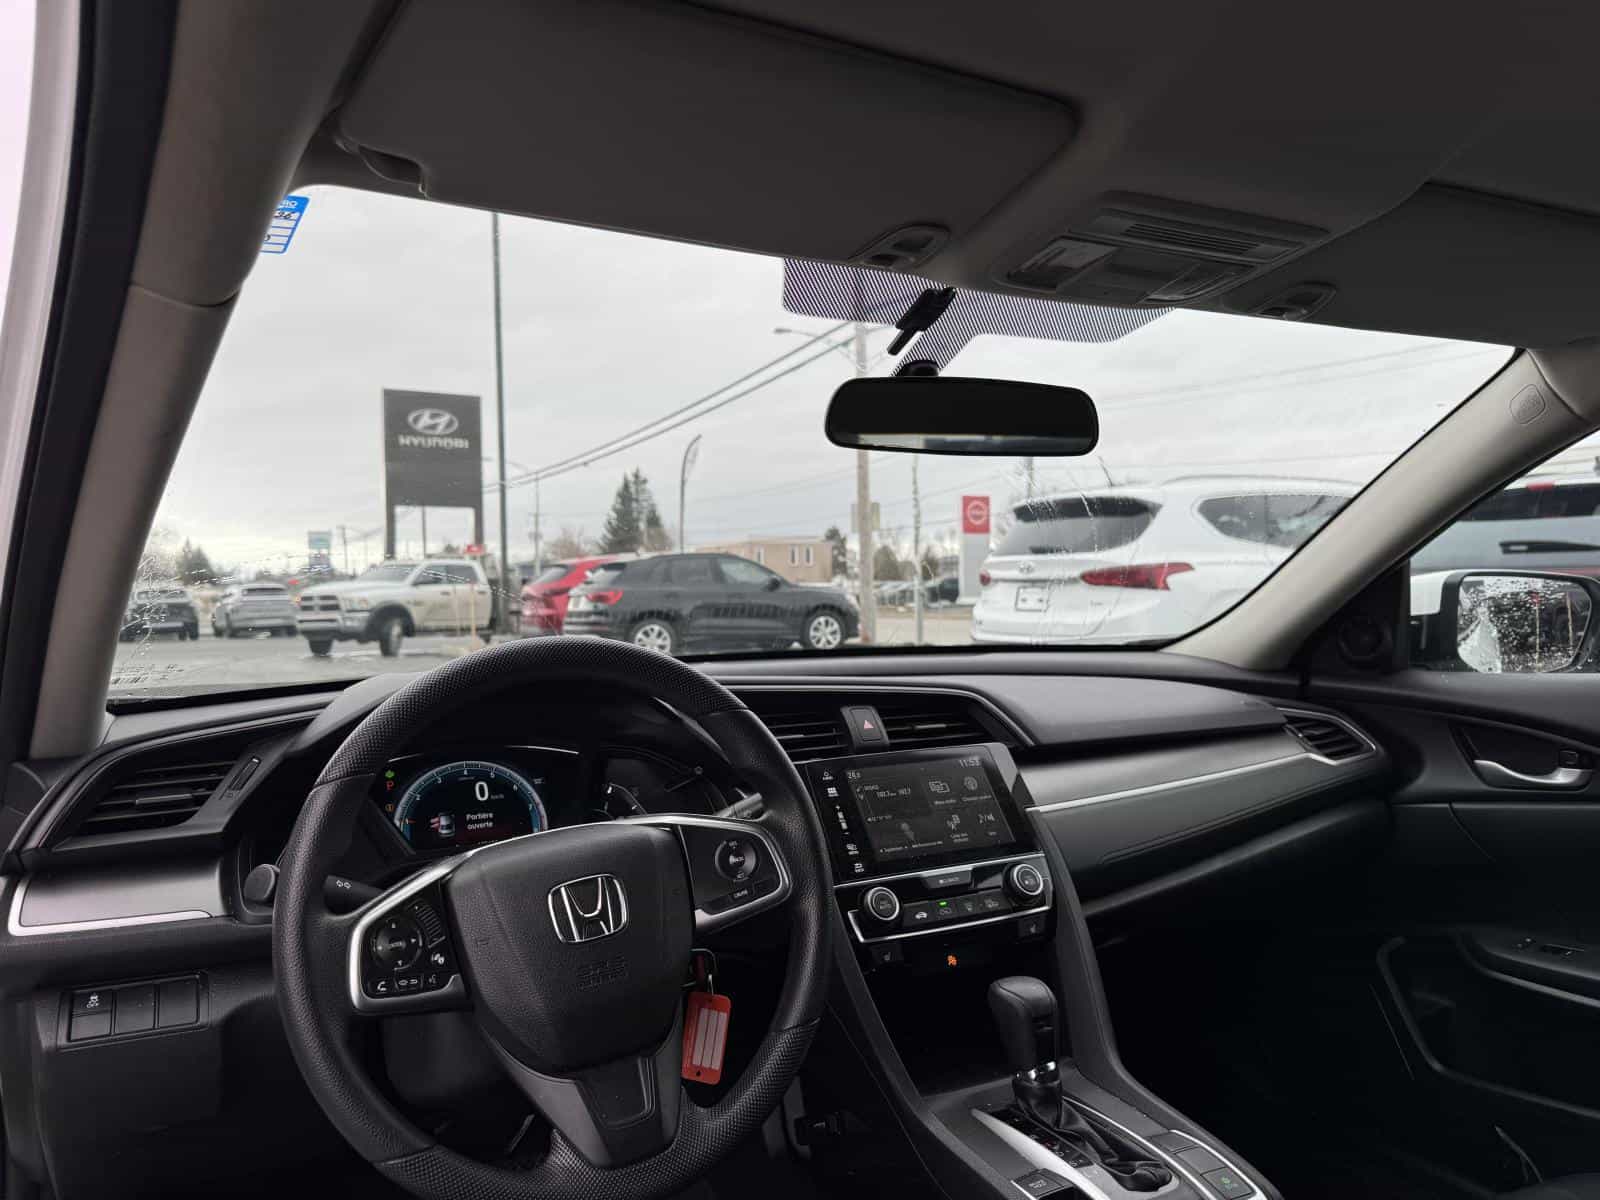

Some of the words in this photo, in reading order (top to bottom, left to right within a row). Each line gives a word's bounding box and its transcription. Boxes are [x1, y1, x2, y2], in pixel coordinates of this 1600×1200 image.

[397, 434, 470, 450] HYUNDAI
[475, 781, 489, 801] 0
[467, 821, 494, 831] ouverte
